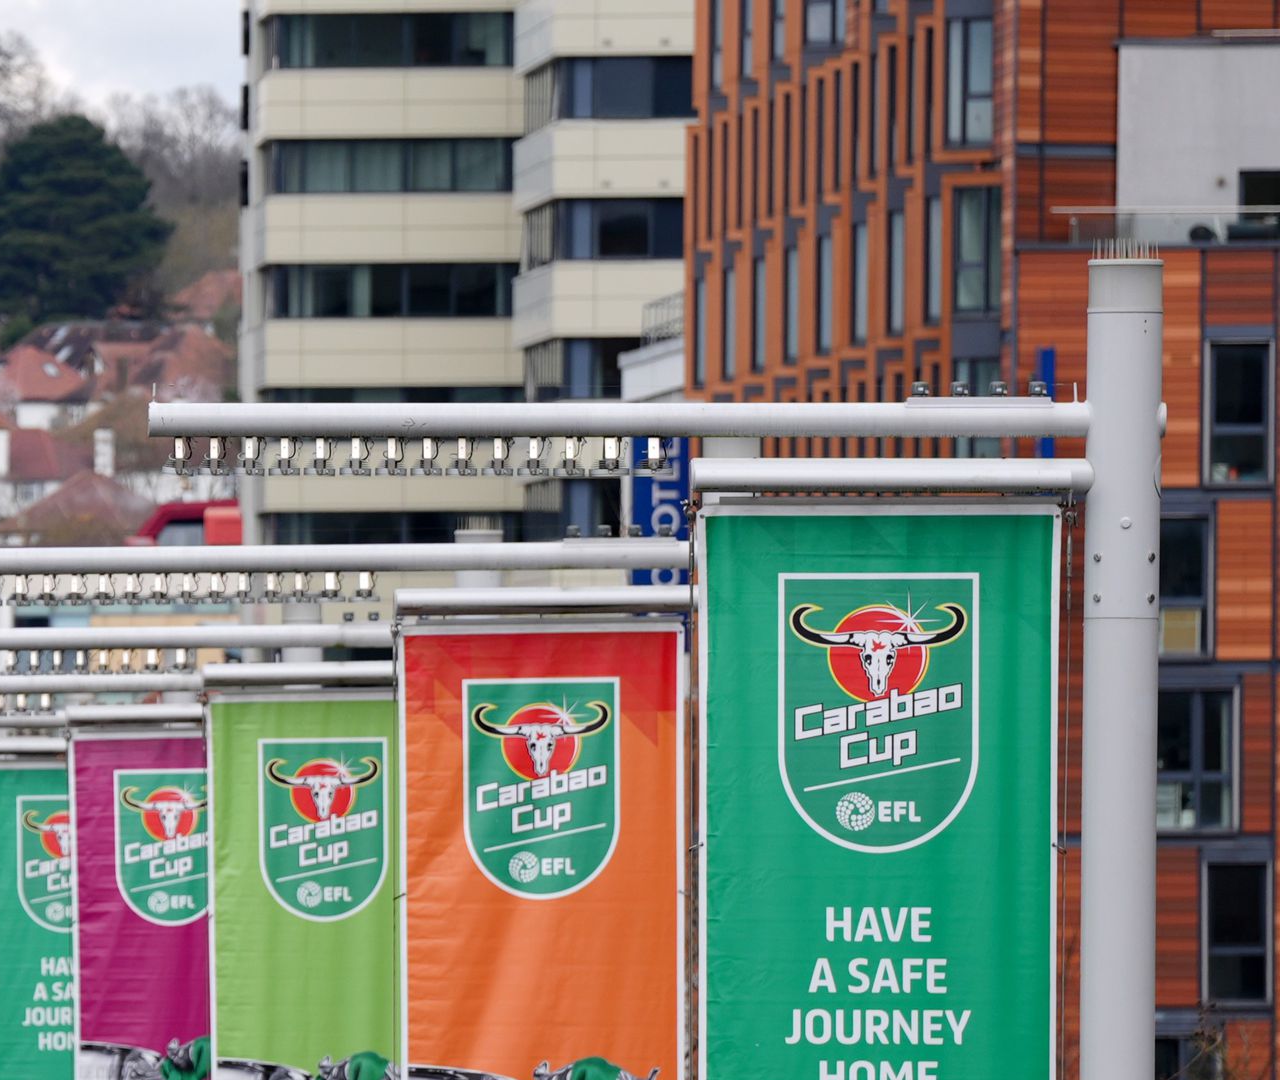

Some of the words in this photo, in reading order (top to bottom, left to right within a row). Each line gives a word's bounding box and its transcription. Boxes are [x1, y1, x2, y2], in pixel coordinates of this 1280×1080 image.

[794, 682, 963, 741] Carabao
[840, 730, 918, 770] Cup
[476, 765, 607, 812] Carabao
[511, 802, 571, 834] Cup
[878, 800, 922, 823] EFL
[269, 810, 378, 849] Carabao
[149, 856, 193, 880] Cup
[298, 841, 349, 867] Cup
[541, 858, 575, 876] EFL
[170, 894, 195, 909] EFL
[323, 887, 352, 902] EFL
[825, 906, 933, 943] HAVE
[808, 959, 837, 994] A
[847, 957, 948, 994] SAFE
[33, 982, 48, 1001] A
[22, 1006, 72, 1027] JOUR
[785, 1008, 972, 1045] JOURNEY
